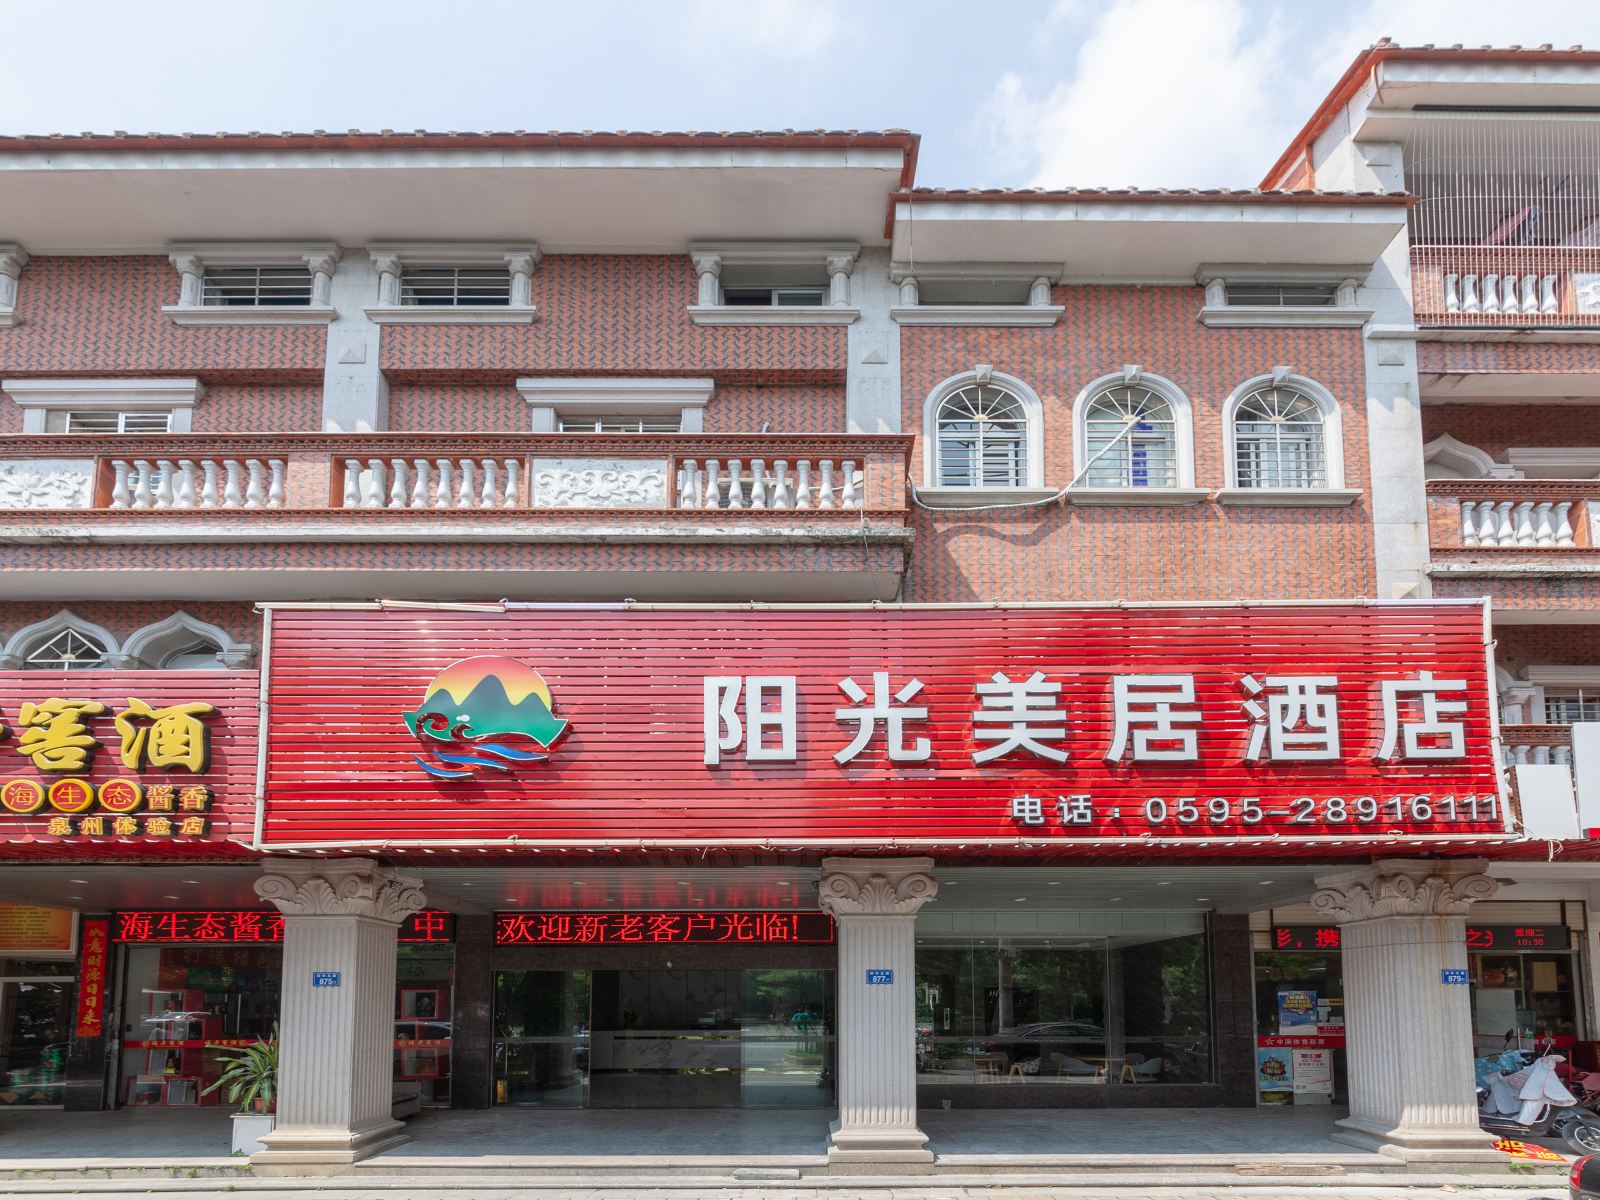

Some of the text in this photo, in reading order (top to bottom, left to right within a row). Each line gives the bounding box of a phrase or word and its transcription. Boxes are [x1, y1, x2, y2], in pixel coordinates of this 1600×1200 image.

[703, 669, 1468, 766] 阳光美居酒店
[8, 783, 208, 811] 海生态酱香
[48, 817, 205, 835] 泉州体验店
[414, 912, 445, 941] 中
[501, 913, 799, 943] 欢迎新老客户光临!
[1517, 938, 1544, 946] 10:30
